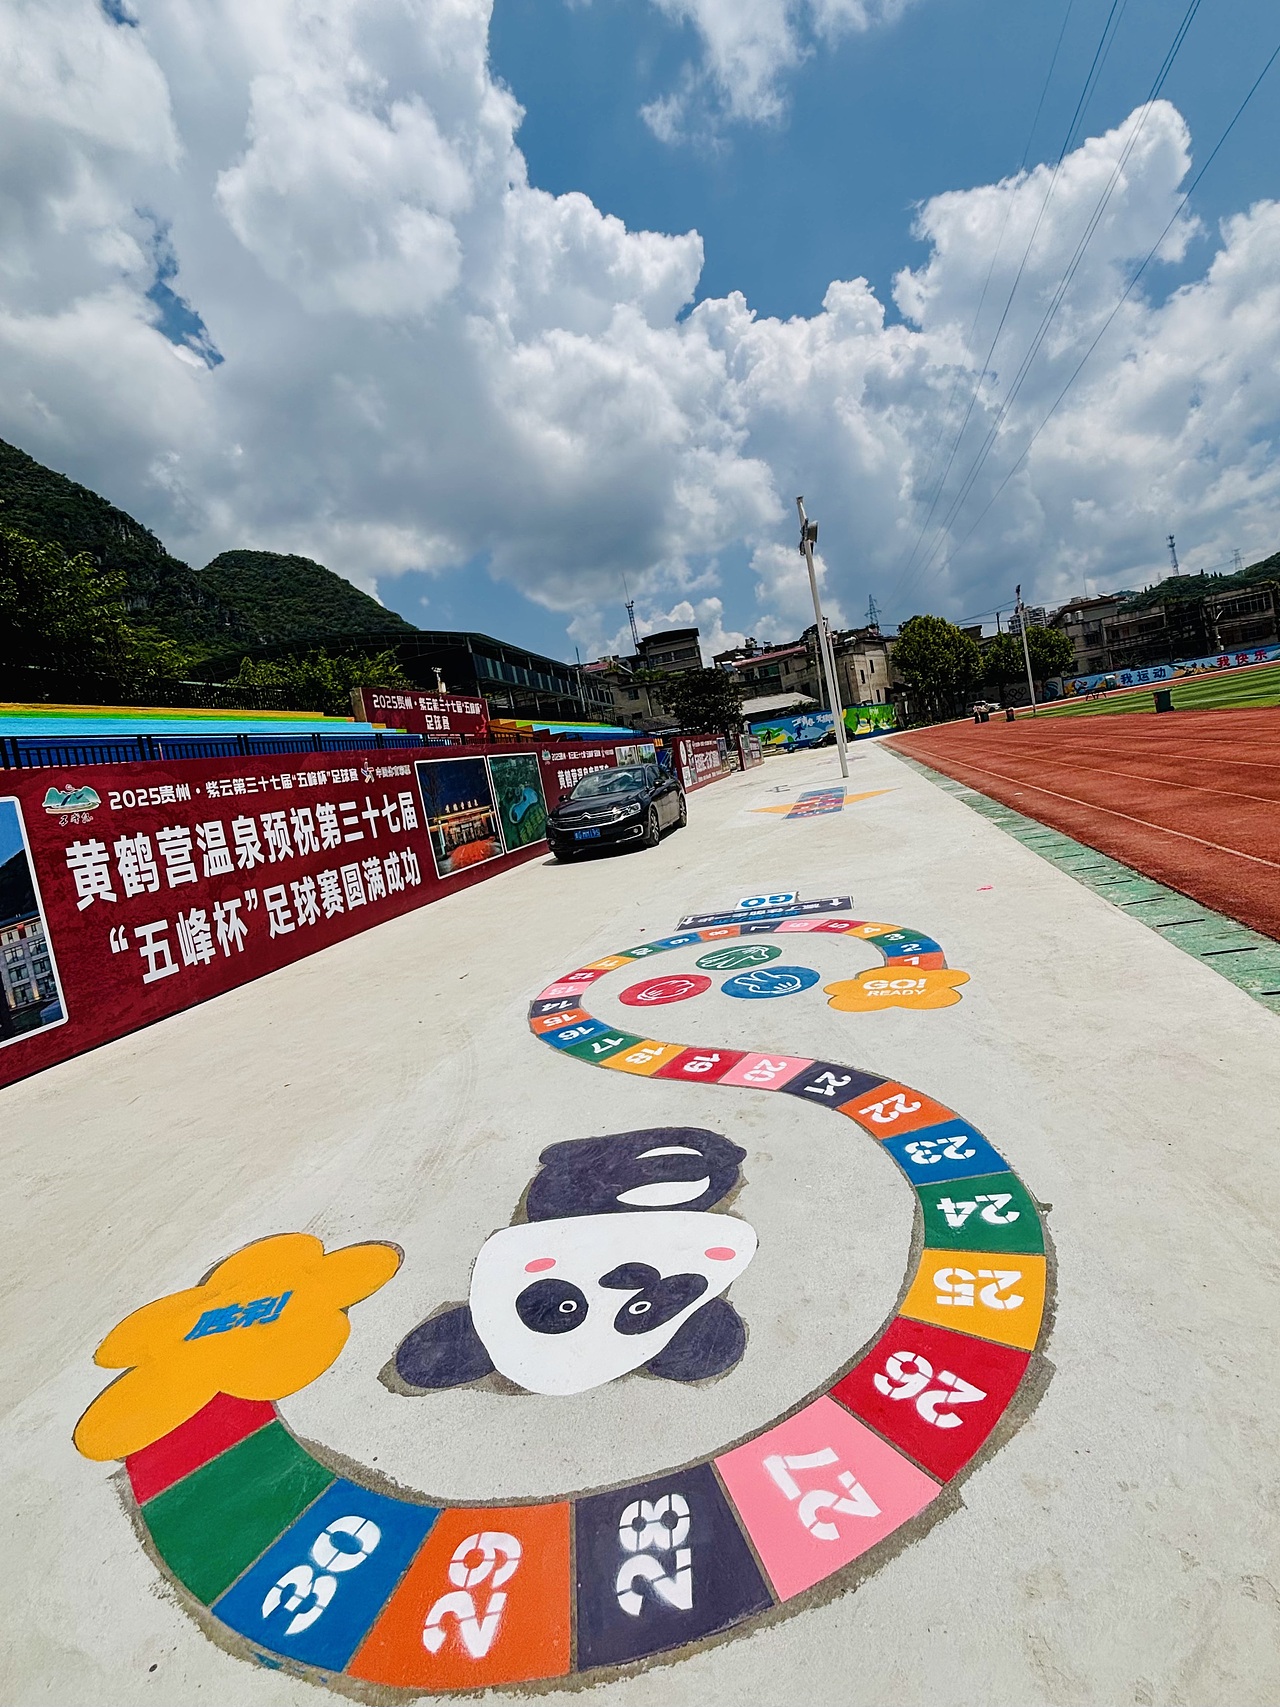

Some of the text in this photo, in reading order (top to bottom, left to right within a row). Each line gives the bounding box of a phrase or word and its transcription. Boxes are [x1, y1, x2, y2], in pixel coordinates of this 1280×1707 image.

[1217, 650, 1268, 667] 我快乐
[1120, 668, 1166, 685] 我运动
[65, 791, 419, 912] 黄鹤营温泉预祝第三十七届
[741, 894, 793, 907] GO
[109, 847, 421, 984] “五峰杯”足球赛圆满成功
[864, 926, 880, 935] 4
[884, 932, 906, 941] 3
[630, 947, 653, 956] 10
[900, 943, 922, 952] 2
[903, 956, 920, 966] 1
[568, 972, 595, 980] 12
[863, 978, 928, 991] GO!
[549, 985, 578, 995] 13
[541, 1000, 573, 1011] 14
[542, 1013, 578, 1026] 15
[558, 1026, 595, 1040] 16
[591, 1036, 624, 1054] 17
[625, 1046, 665, 1064] 18
[683, 1053, 721, 1073] 19
[743, 1059, 787, 1081] 20
[803, 1071, 852, 1097] 21
[858, 1093, 922, 1123] 22
[904, 1135, 976, 1165] 23
[936, 1193, 1020, 1228] 24
[933, 1267, 1025, 1310] 25
[874, 1350, 988, 1429] 26
[763, 1447, 882, 1541] 27
[616, 1493, 693, 1616] 28
[261, 1515, 381, 1636] 30
[423, 1531, 523, 1659] 29
